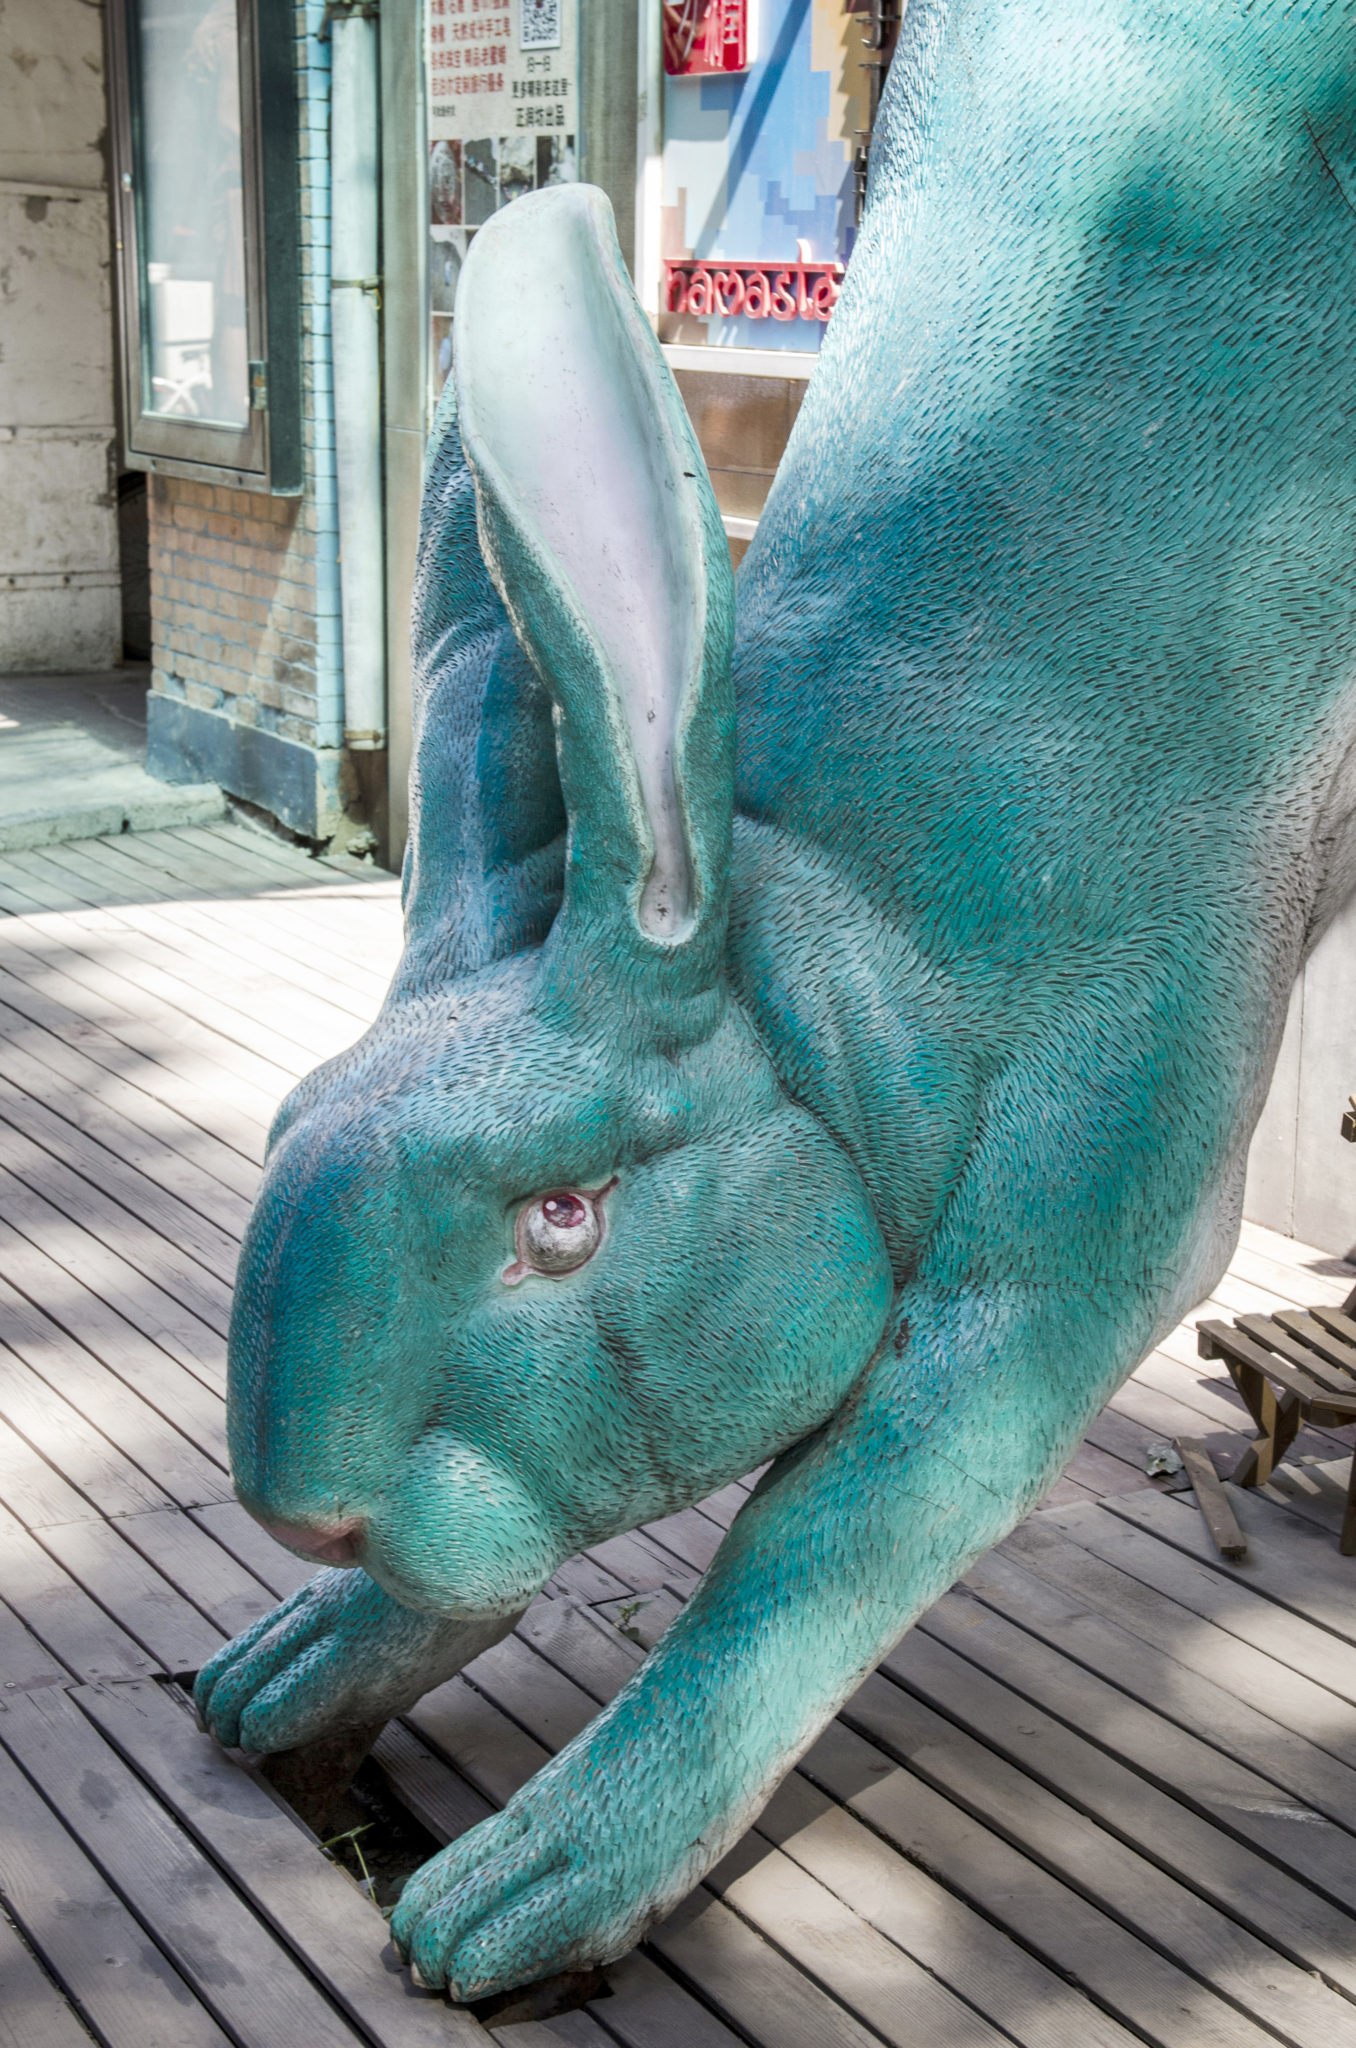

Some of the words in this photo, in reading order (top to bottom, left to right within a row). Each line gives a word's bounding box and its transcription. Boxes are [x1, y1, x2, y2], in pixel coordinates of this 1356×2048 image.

[527, 55, 551, 73] 扫一扫
[512, 78, 568, 98] 更多精彩在这里
[664, 239, 844, 321] namaste
